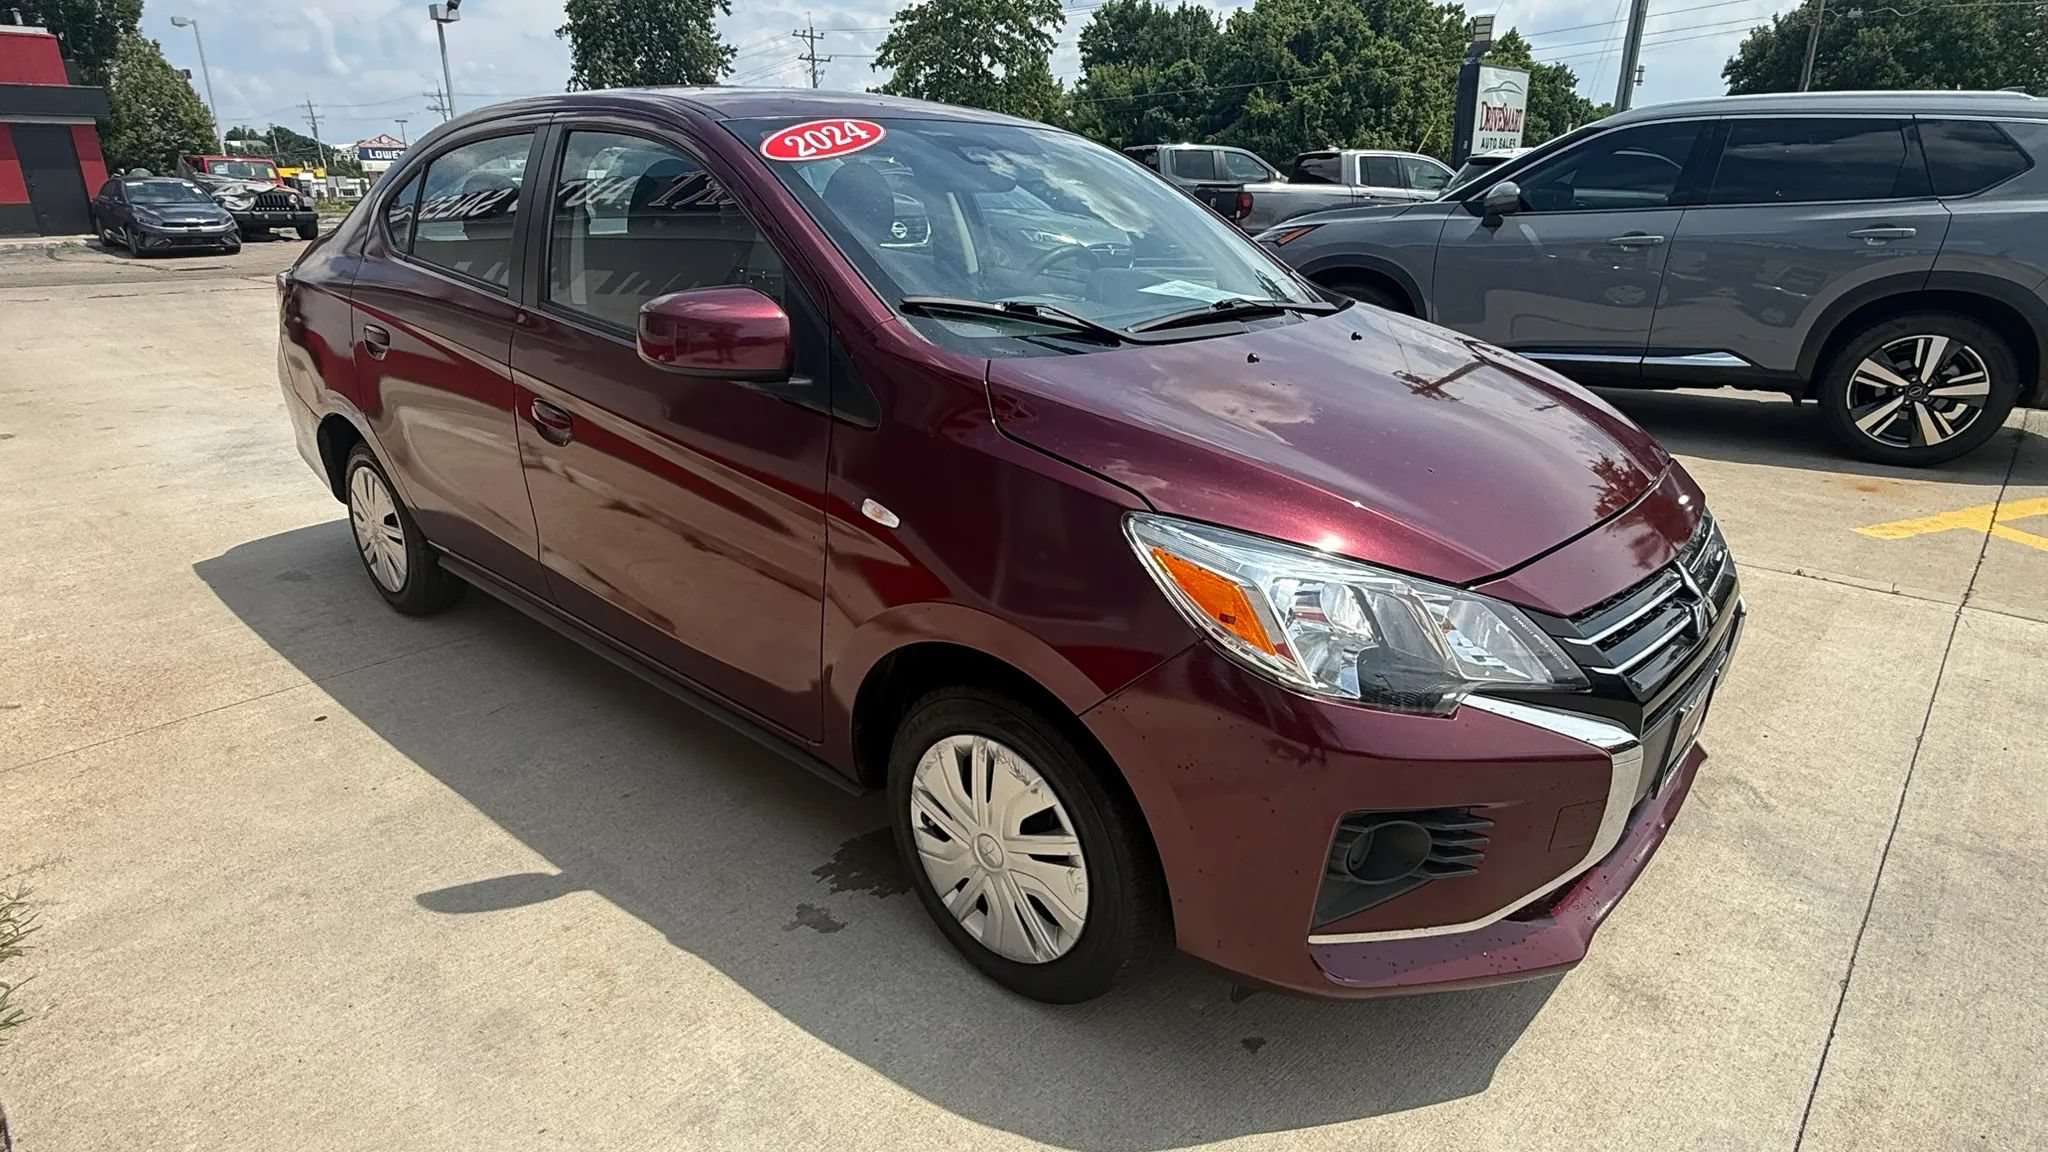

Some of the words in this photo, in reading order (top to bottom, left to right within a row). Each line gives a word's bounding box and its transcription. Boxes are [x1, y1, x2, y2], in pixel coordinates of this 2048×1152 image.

[784, 121, 871, 157] 2024
[1480, 137, 1497, 149] AUTO
[1498, 138, 1516, 149] SALES
